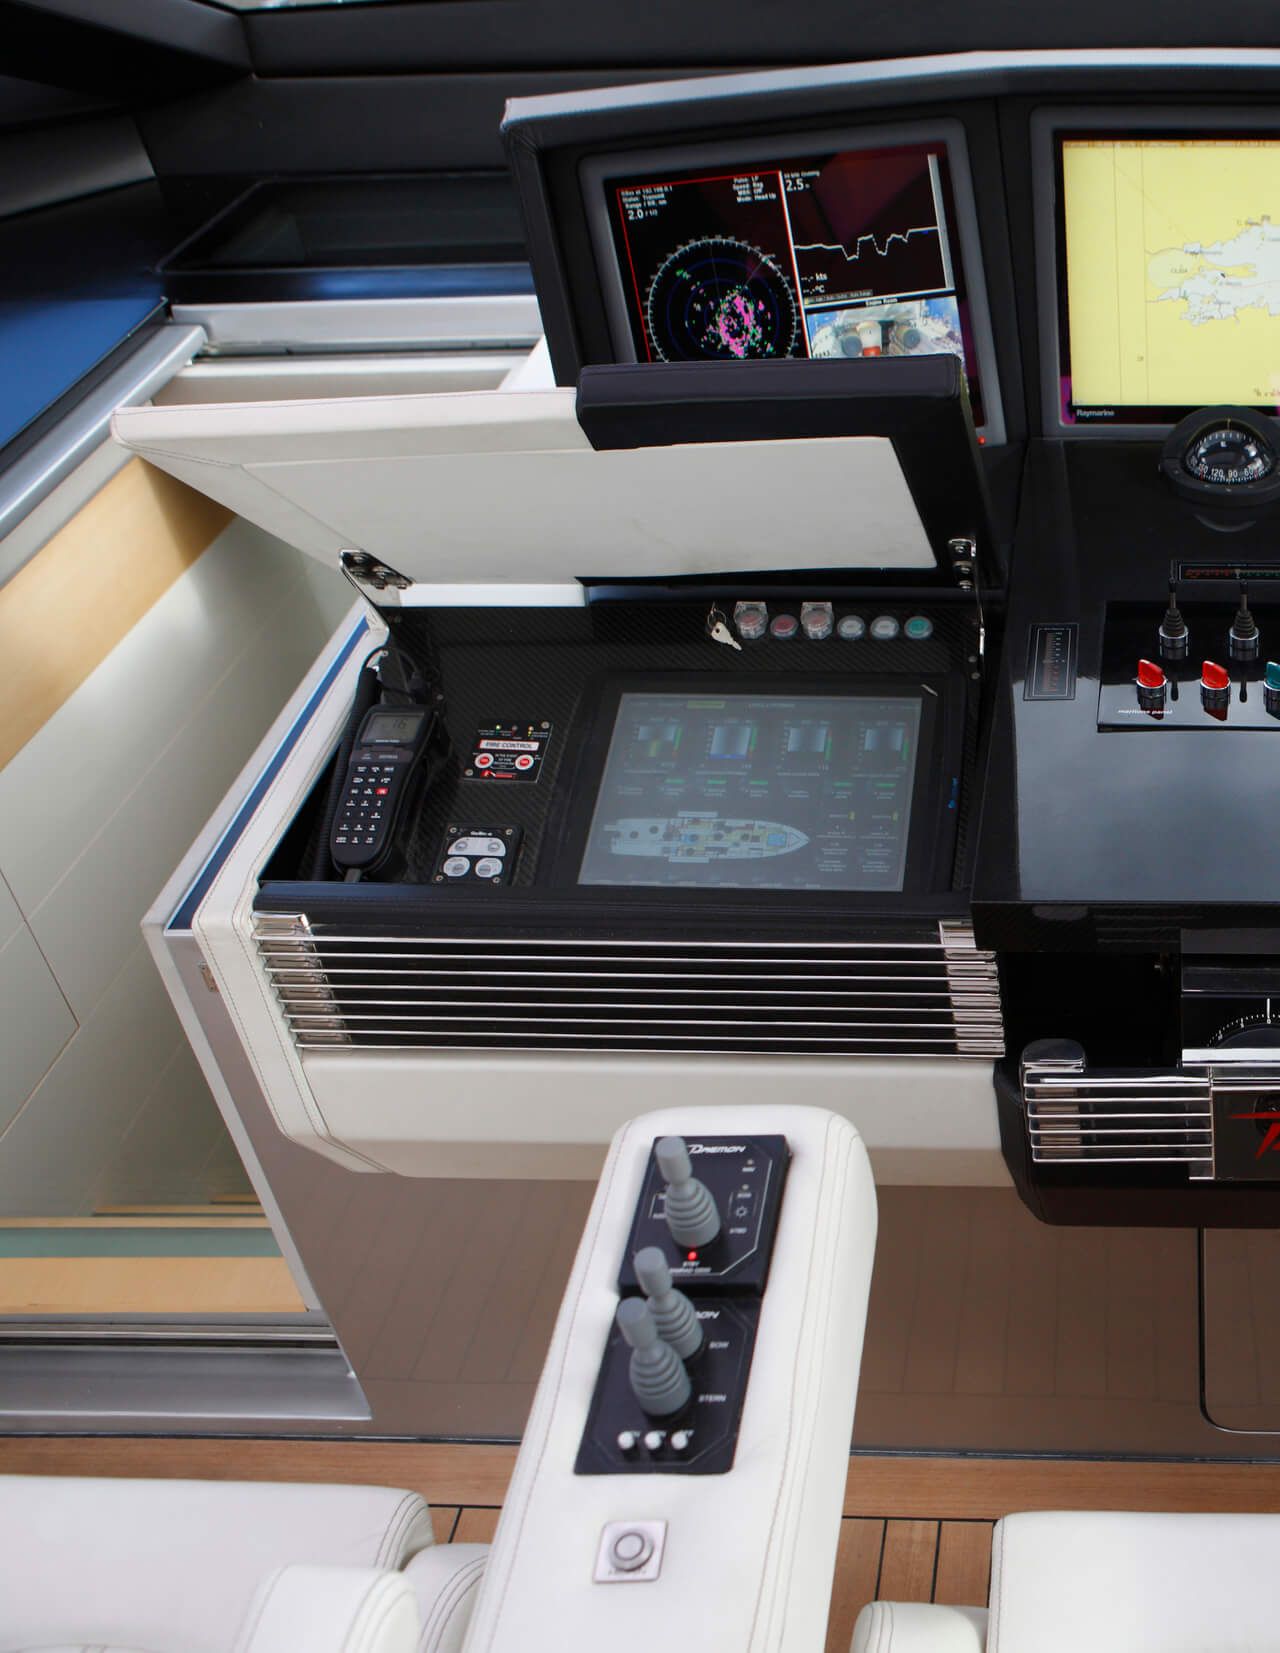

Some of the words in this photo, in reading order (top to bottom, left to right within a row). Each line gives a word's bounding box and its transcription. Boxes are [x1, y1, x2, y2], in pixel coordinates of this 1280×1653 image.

[785, 178, 804, 192] 2.5
[628, 209, 644, 220] 2.0
[1076, 409, 1115, 418] Raymarine
